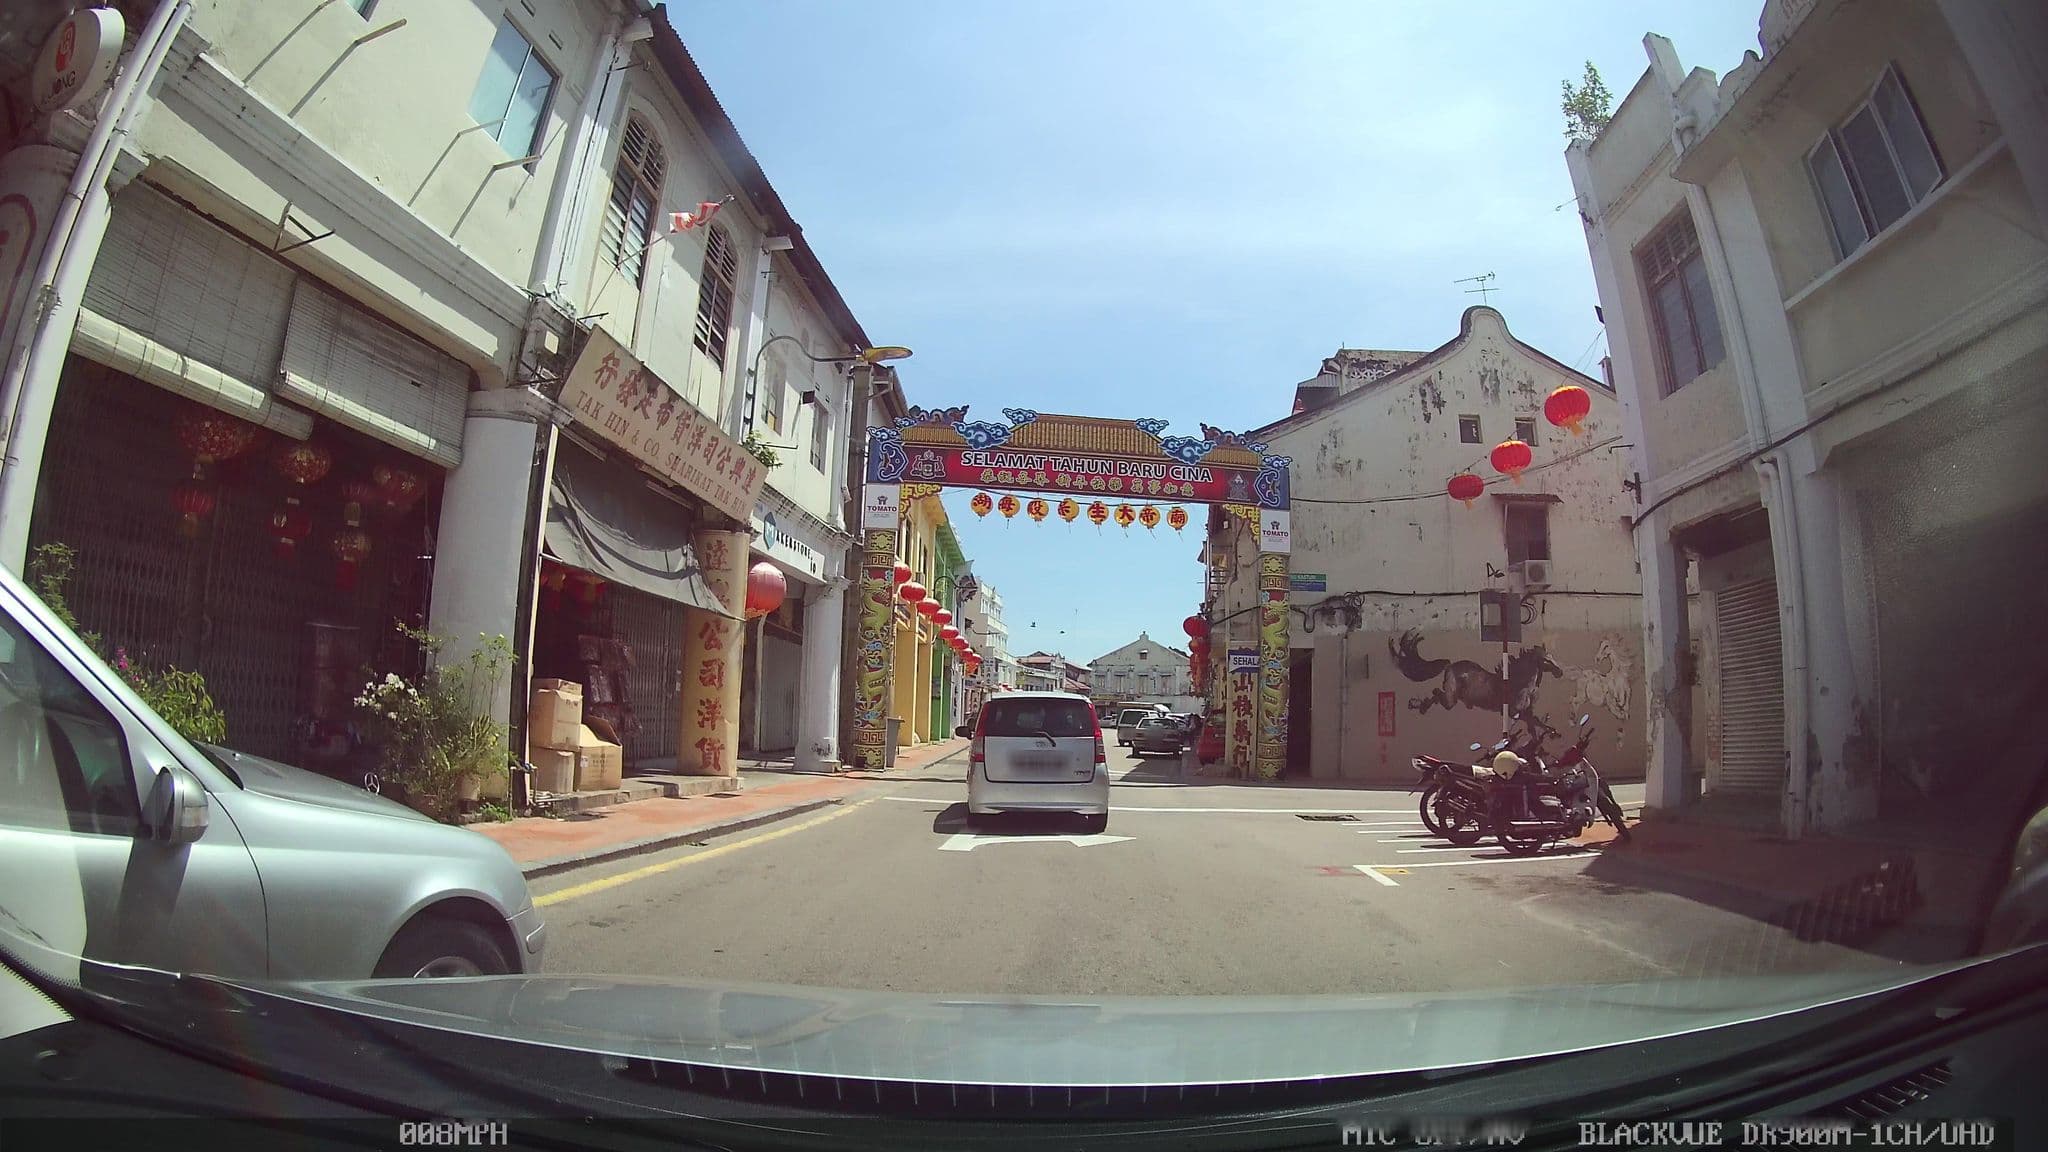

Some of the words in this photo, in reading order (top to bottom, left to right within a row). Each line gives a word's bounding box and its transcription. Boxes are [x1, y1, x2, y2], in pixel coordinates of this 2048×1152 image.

[576, 390, 603, 422] TAK
[604, 411, 630, 437] HIN
[631, 429, 639, 446] &
[664, 451, 713, 493] SHARIKAT
[713, 484, 730, 507] TAK
[962, 451, 1047, 470] SELAMAT
[1051, 457, 1113, 475] TAHUN
[1117, 462, 1166, 478] BARU
[1170, 465, 1213, 482] CINA
